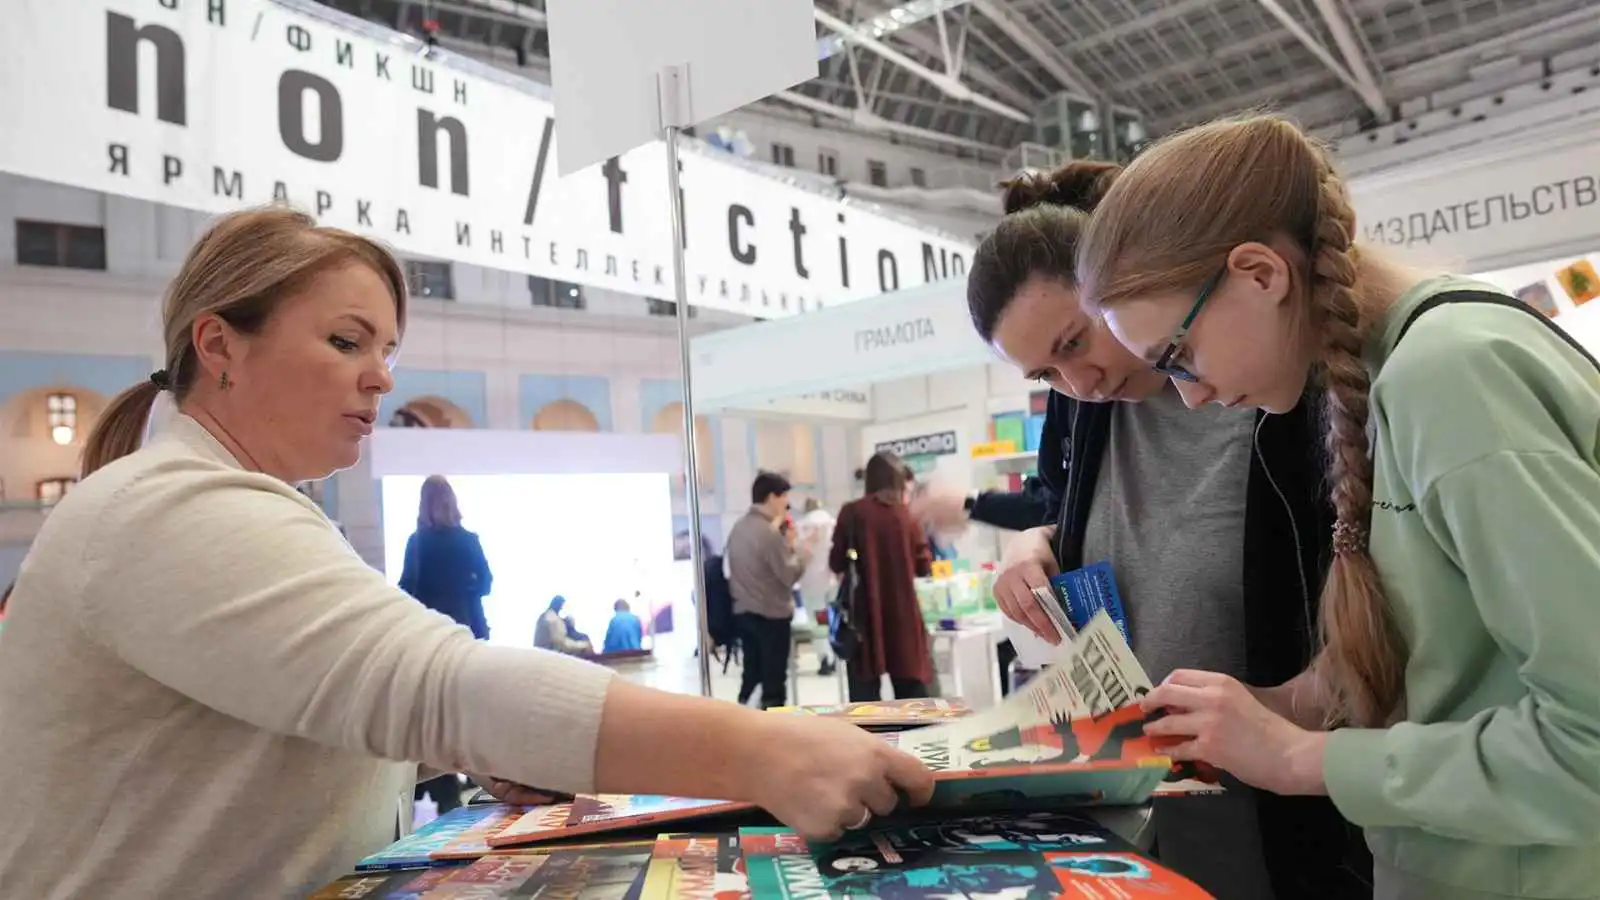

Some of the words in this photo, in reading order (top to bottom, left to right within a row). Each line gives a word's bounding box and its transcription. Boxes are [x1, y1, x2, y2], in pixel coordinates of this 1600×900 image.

[108, 143, 412, 235] ЯРМАРКА
[1364, 175, 1600, 247] ИЗДАТЕЛЬСТВ
[854, 317, 936, 354] ГРАМОТА
